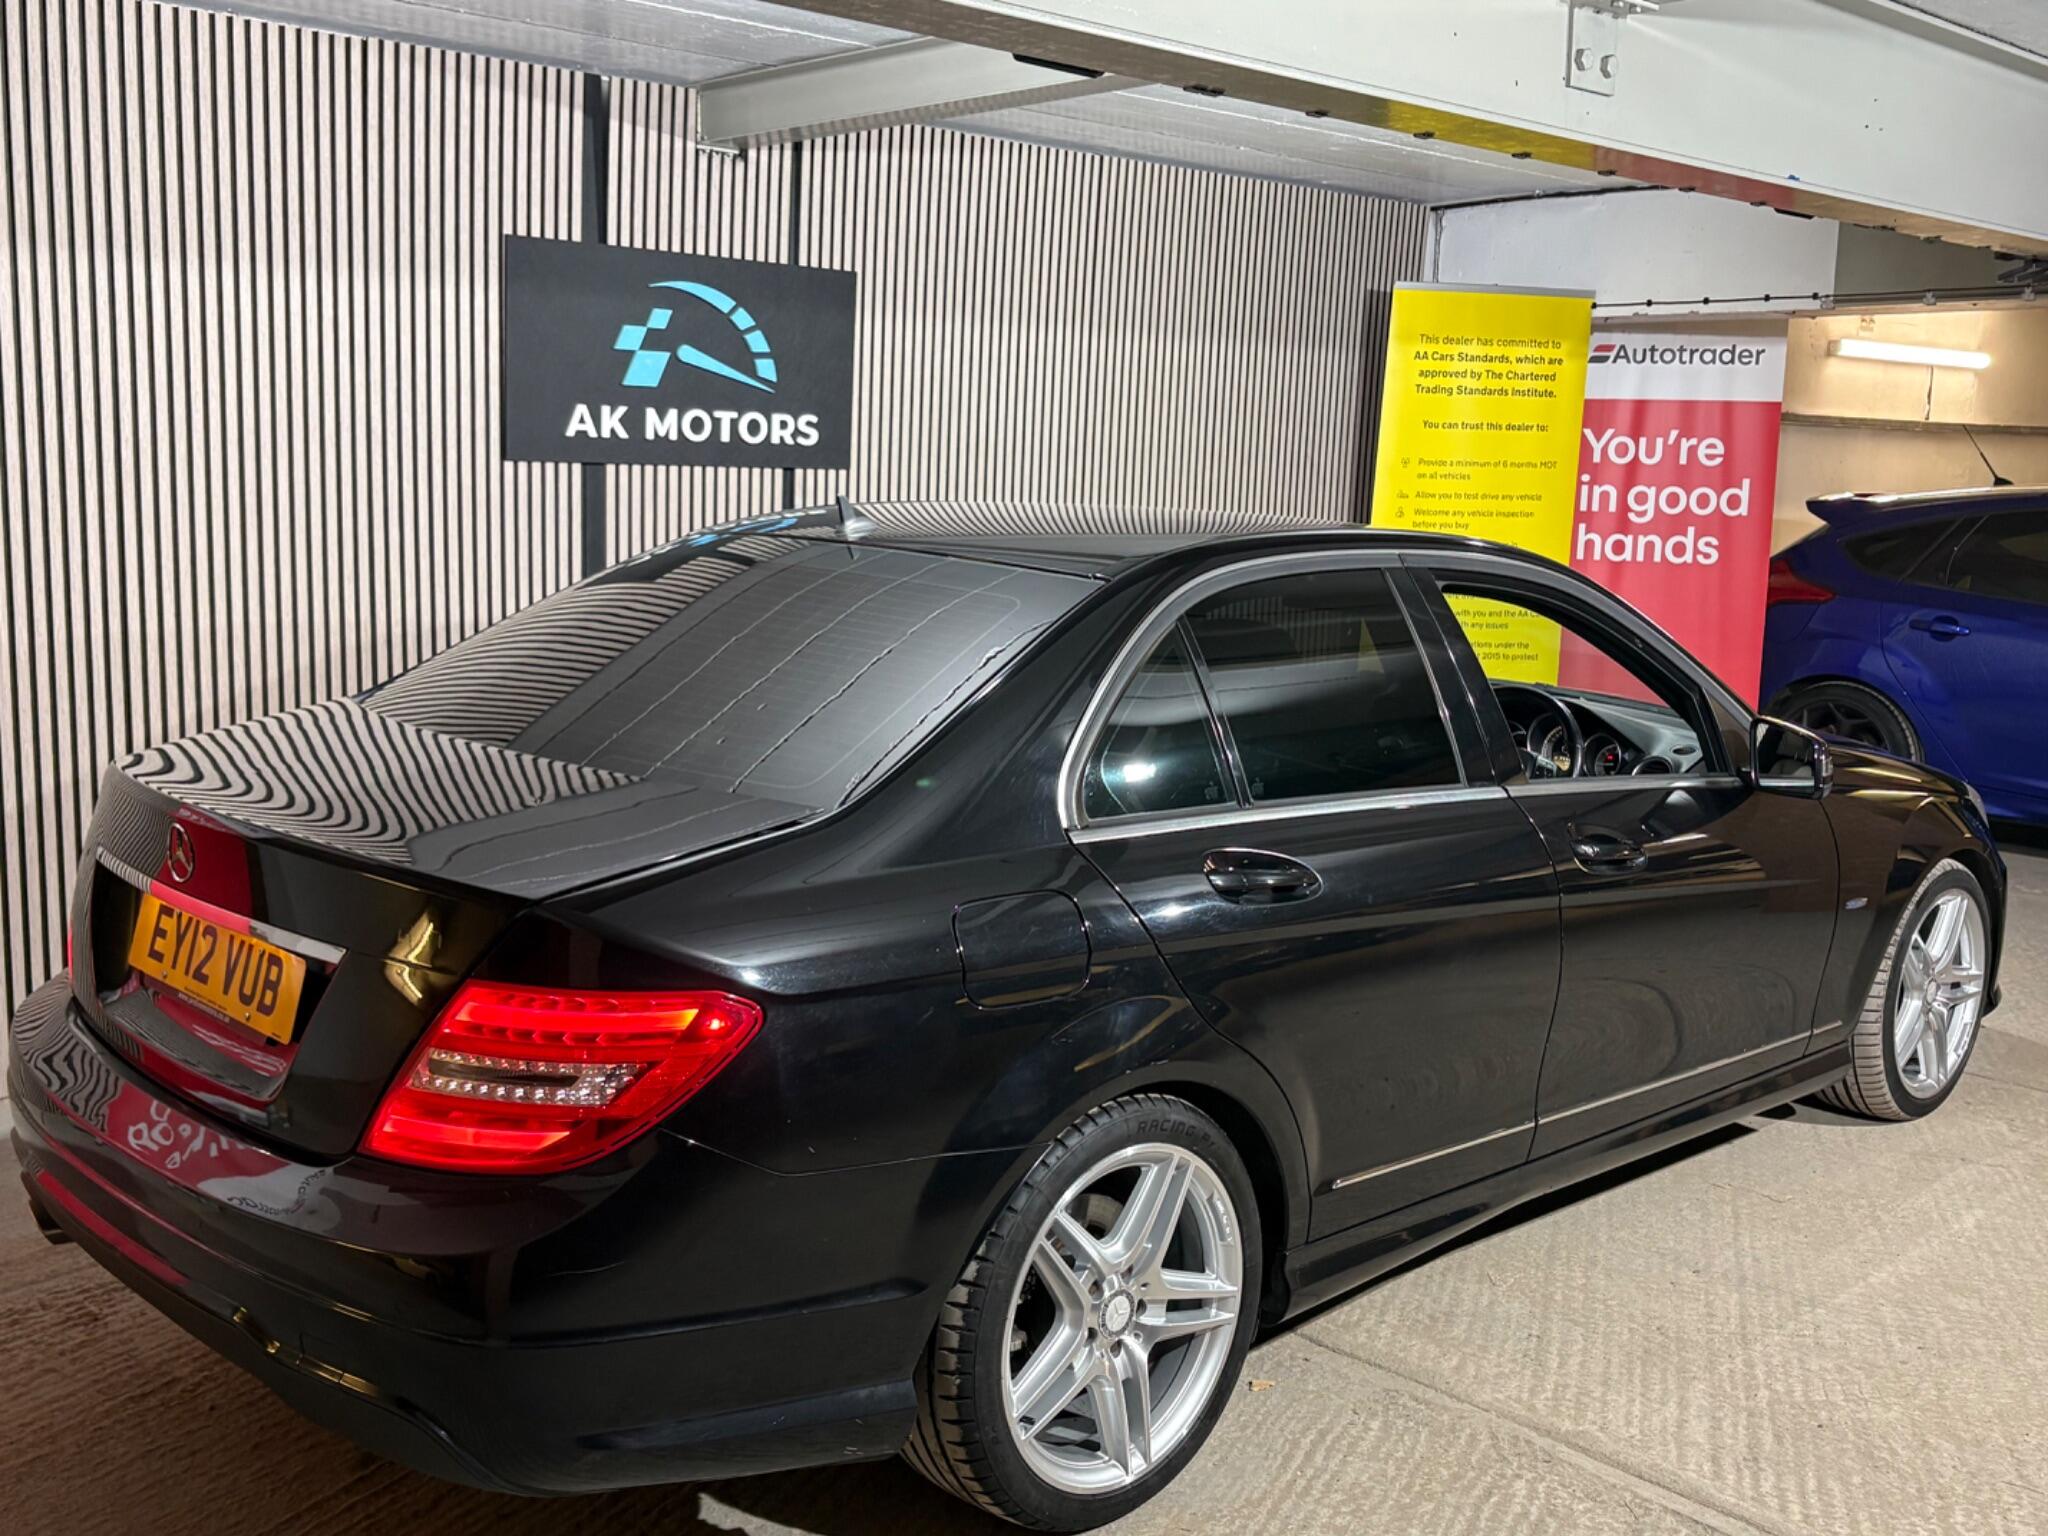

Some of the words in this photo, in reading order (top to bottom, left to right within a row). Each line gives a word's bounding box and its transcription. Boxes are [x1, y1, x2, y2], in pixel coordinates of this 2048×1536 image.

[1420, 334, 1440, 345] This
[1442, 335, 1475, 345] dealer
[1476, 336, 1494, 346] has
[1497, 337, 1549, 349] committed
[1552, 339, 1561, 349] to
[1414, 351, 1428, 360] AA
[1431, 351, 1455, 361] Cars
[1457, 352, 1512, 365] Standards,
[1515, 354, 1545, 365] which
[1547, 357, 1563, 366] are
[1612, 344, 1766, 366] Autotrader
[1418, 368, 1467, 379] approved
[1470, 369, 1482, 380] by
[1485, 369, 1503, 380] The
[1505, 370, 1556, 382] Chartered
[1415, 384, 1453, 396] Trading
[1456, 385, 1509, 397] Standards
[1511, 387, 1557, 398] Institute.
[565, 403, 630, 439] AK
[644, 406, 820, 446] MOTORS
[1423, 420, 1439, 430] You
[1441, 422, 1458, 430] can
[1461, 421, 1484, 431] trust
[1486, 421, 1503, 431] this
[1505, 422, 1534, 432] dealer
[1536, 423, 1549, 432] to:
[1418, 458, 1447, 467] Provide
[1456, 459, 1492, 468] minimum
[1493, 459, 1501, 468] of
[1502, 460, 1508, 468] 6
[1510, 460, 1538, 469] months
[1539, 461, 1557, 469] MOT
[1439, 472, 1471, 480] vehicles
[1415, 491, 1436, 499] Allow
[1438, 493, 1452, 501] you
[1464, 492, 1479, 500] test
[1481, 492, 1499, 500] drive
[1516, 493, 1542, 501] vehicle
[1579, 474, 1617, 513] in
[1626, 478, 1751, 523] good
[1414, 508, 1449, 517] Welcome
[1452, 510, 1466, 518] any
[1467, 509, 1494, 517] vehicle
[1496, 509, 1535, 518] inspection
[1412, 520, 1437, 529] before
[1439, 522, 1453, 530] you
[1455, 521, 1469, 530] buy
[1576, 523, 1719, 565] hands
[1472, 610, 1486, 618] you
[1471, 622, 1484, 630] any
[1494, 641, 1516, 649] under
[1517, 641, 1529, 649] the
[1482, 652, 1500, 660] 2015
[1511, 653, 1539, 661] protect
[147, 903, 219, 985] EY12
[222, 934, 284, 1017] VUB
[1137, 1120, 1197, 1136] RACING
